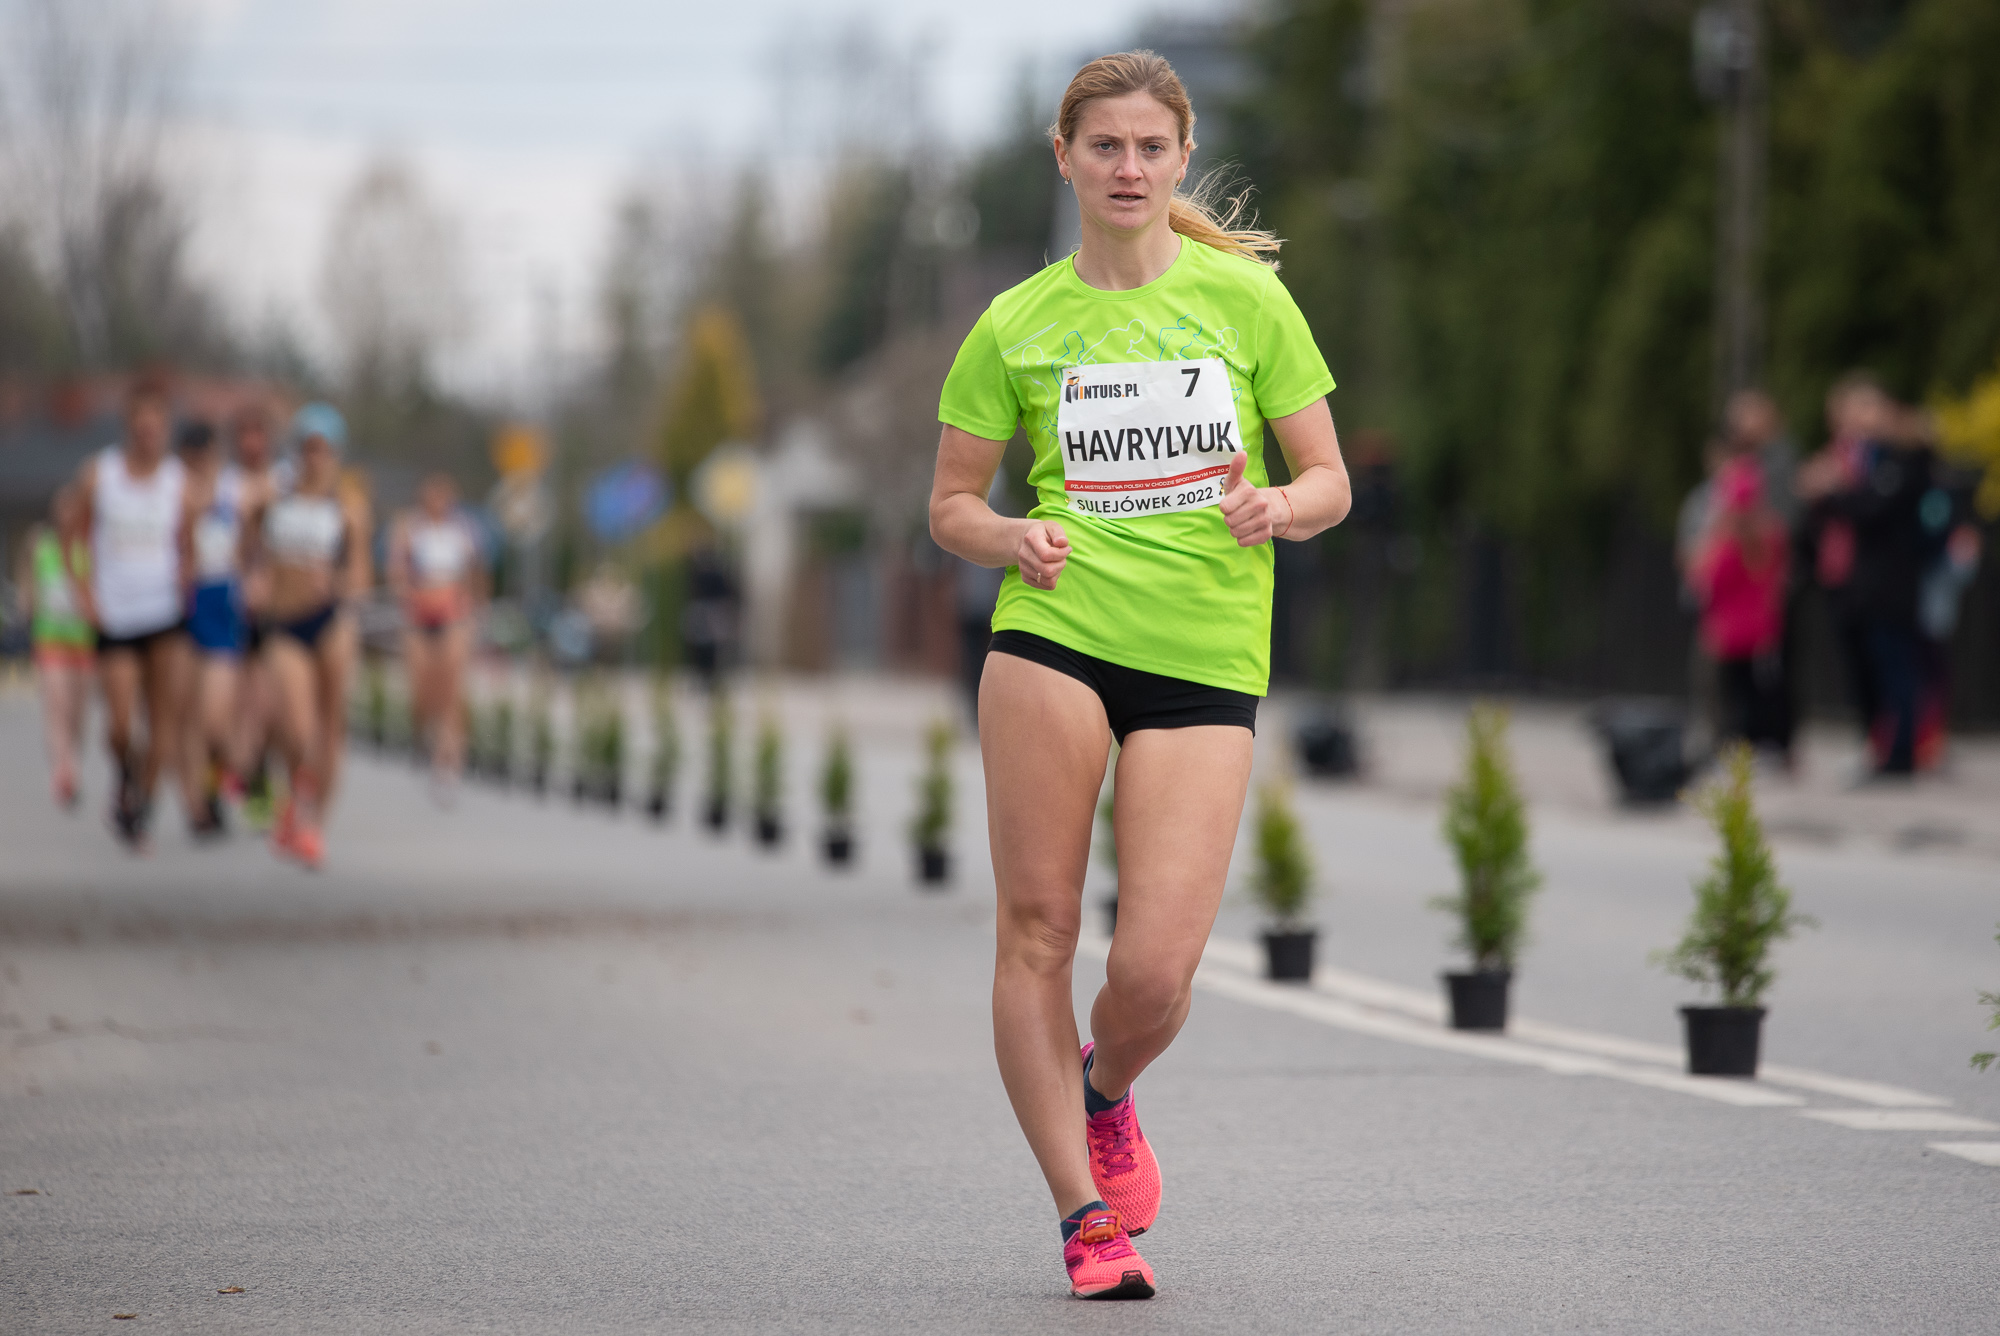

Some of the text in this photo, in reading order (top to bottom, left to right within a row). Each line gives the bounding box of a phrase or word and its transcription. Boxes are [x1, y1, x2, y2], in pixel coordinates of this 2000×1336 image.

[1079, 383, 1140, 400] INTUIS.PL
[1181, 367, 1201, 398] 7
[1065, 421, 1236, 462] HAVRYLYUK
[1151, 479, 1174, 487] CHODZIE
[1175, 471, 1209, 484] SPORTOWYM
[1077, 487, 1213, 513] SULEJÓWEK 2022
